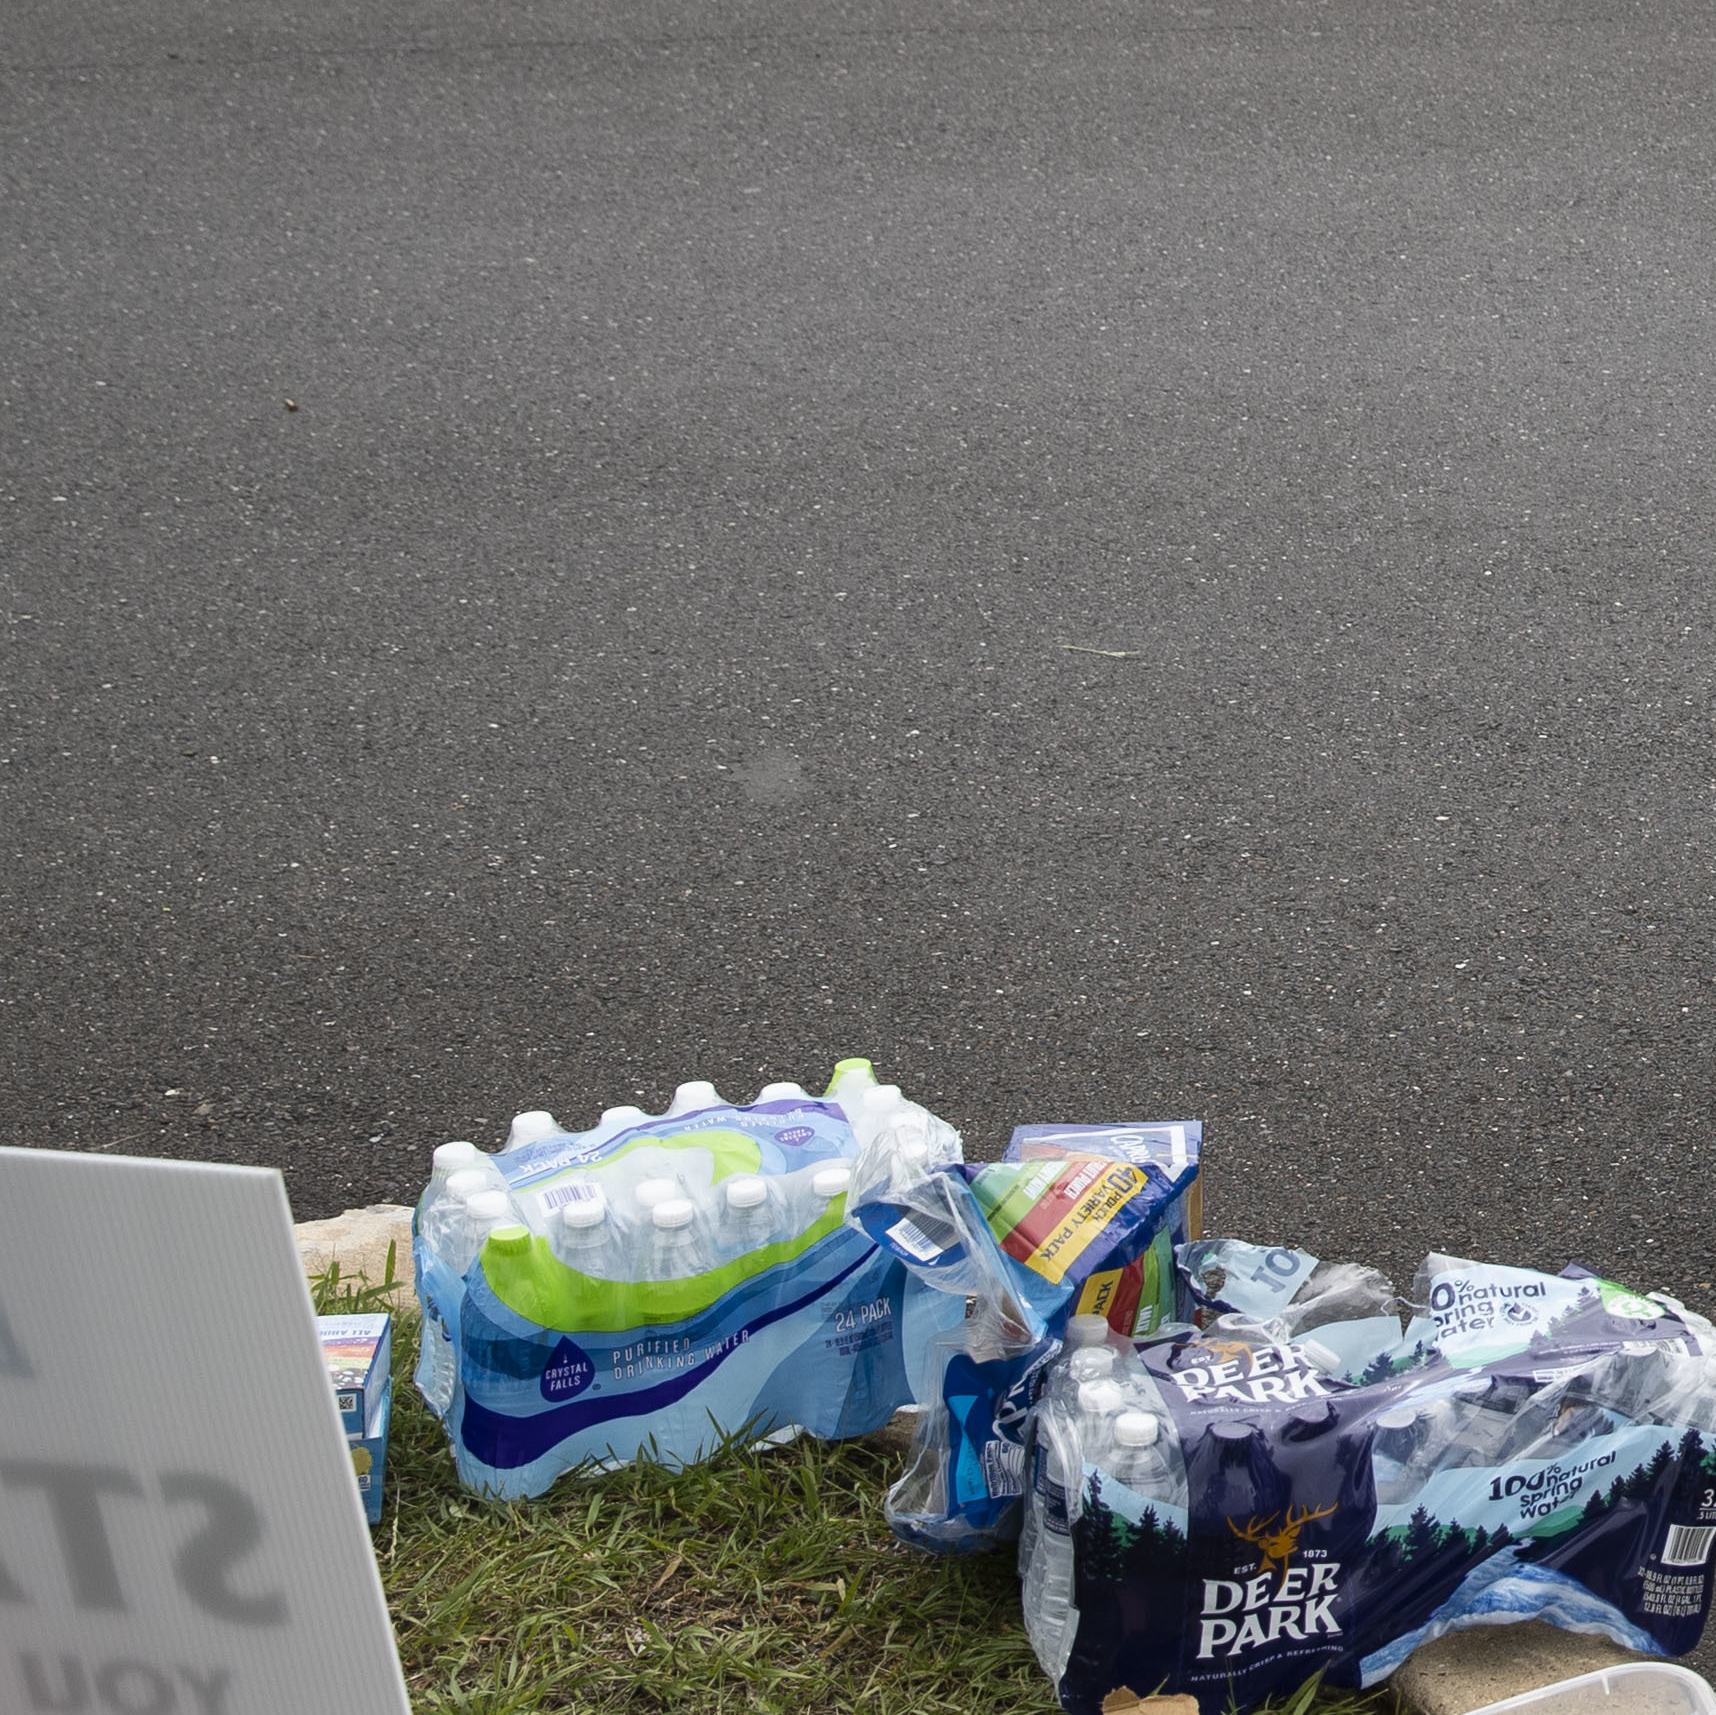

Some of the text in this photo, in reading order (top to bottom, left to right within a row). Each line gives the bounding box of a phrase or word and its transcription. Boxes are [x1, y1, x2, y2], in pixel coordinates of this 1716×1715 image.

[1106, 1160, 1142, 1196] 40
[1068, 1179, 1113, 1230] VARIETY
[1038, 1225, 1073, 1263] PACK
[1459, 1282, 1547, 1305] natural
[834, 1297, 891, 1333] 24 PACK
[1436, 1316, 1495, 1338] ater
[612, 1337, 691, 1364] PURIFIED
[614, 1330, 750, 1381] DRINKING WATER
[1172, 1344, 1317, 1389] DEER
[546, 1362, 588, 1380] CRYSTAL
[550, 1375, 581, 1392] FALLS
[1181, 1369, 1331, 1404] PARK
[1489, 1451, 1616, 1501] 100% natural
[1520, 1476, 1583, 1507] spring
[1234, 1562, 1257, 1574] EST.
[1200, 1563, 1341, 1614] DEER
[1196, 1594, 1342, 1659] PARK
[1191, 1668, 1247, 1682] NATURALLY
